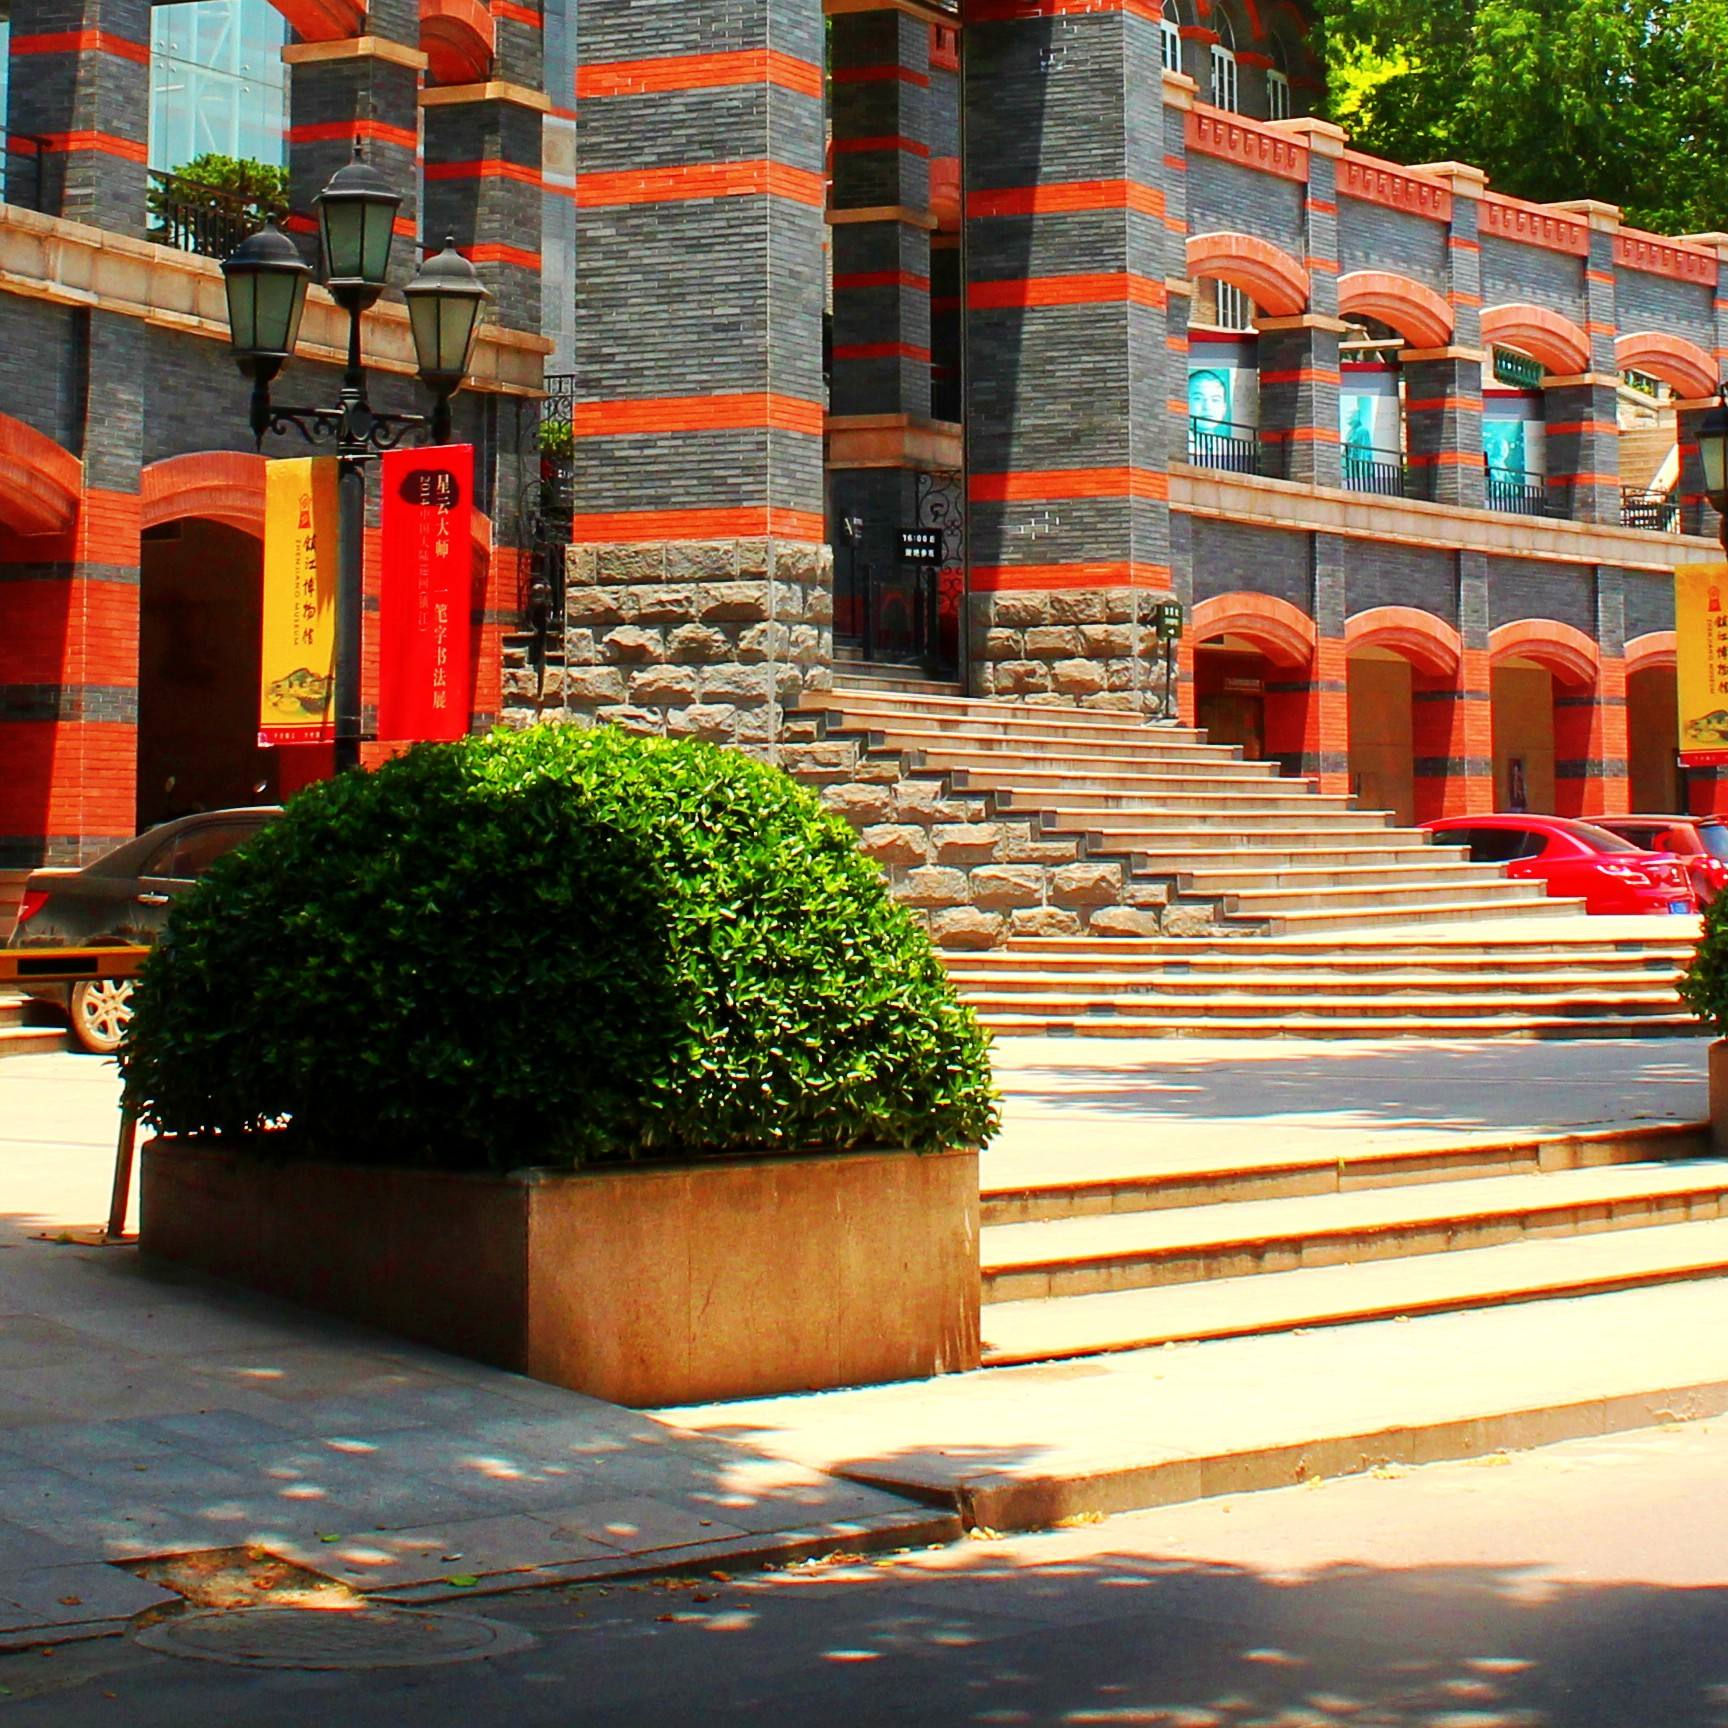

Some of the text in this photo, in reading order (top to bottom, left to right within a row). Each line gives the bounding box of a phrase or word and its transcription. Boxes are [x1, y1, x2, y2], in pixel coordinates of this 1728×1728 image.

[432, 474, 451, 709] 星云大师 一笔字书法展
